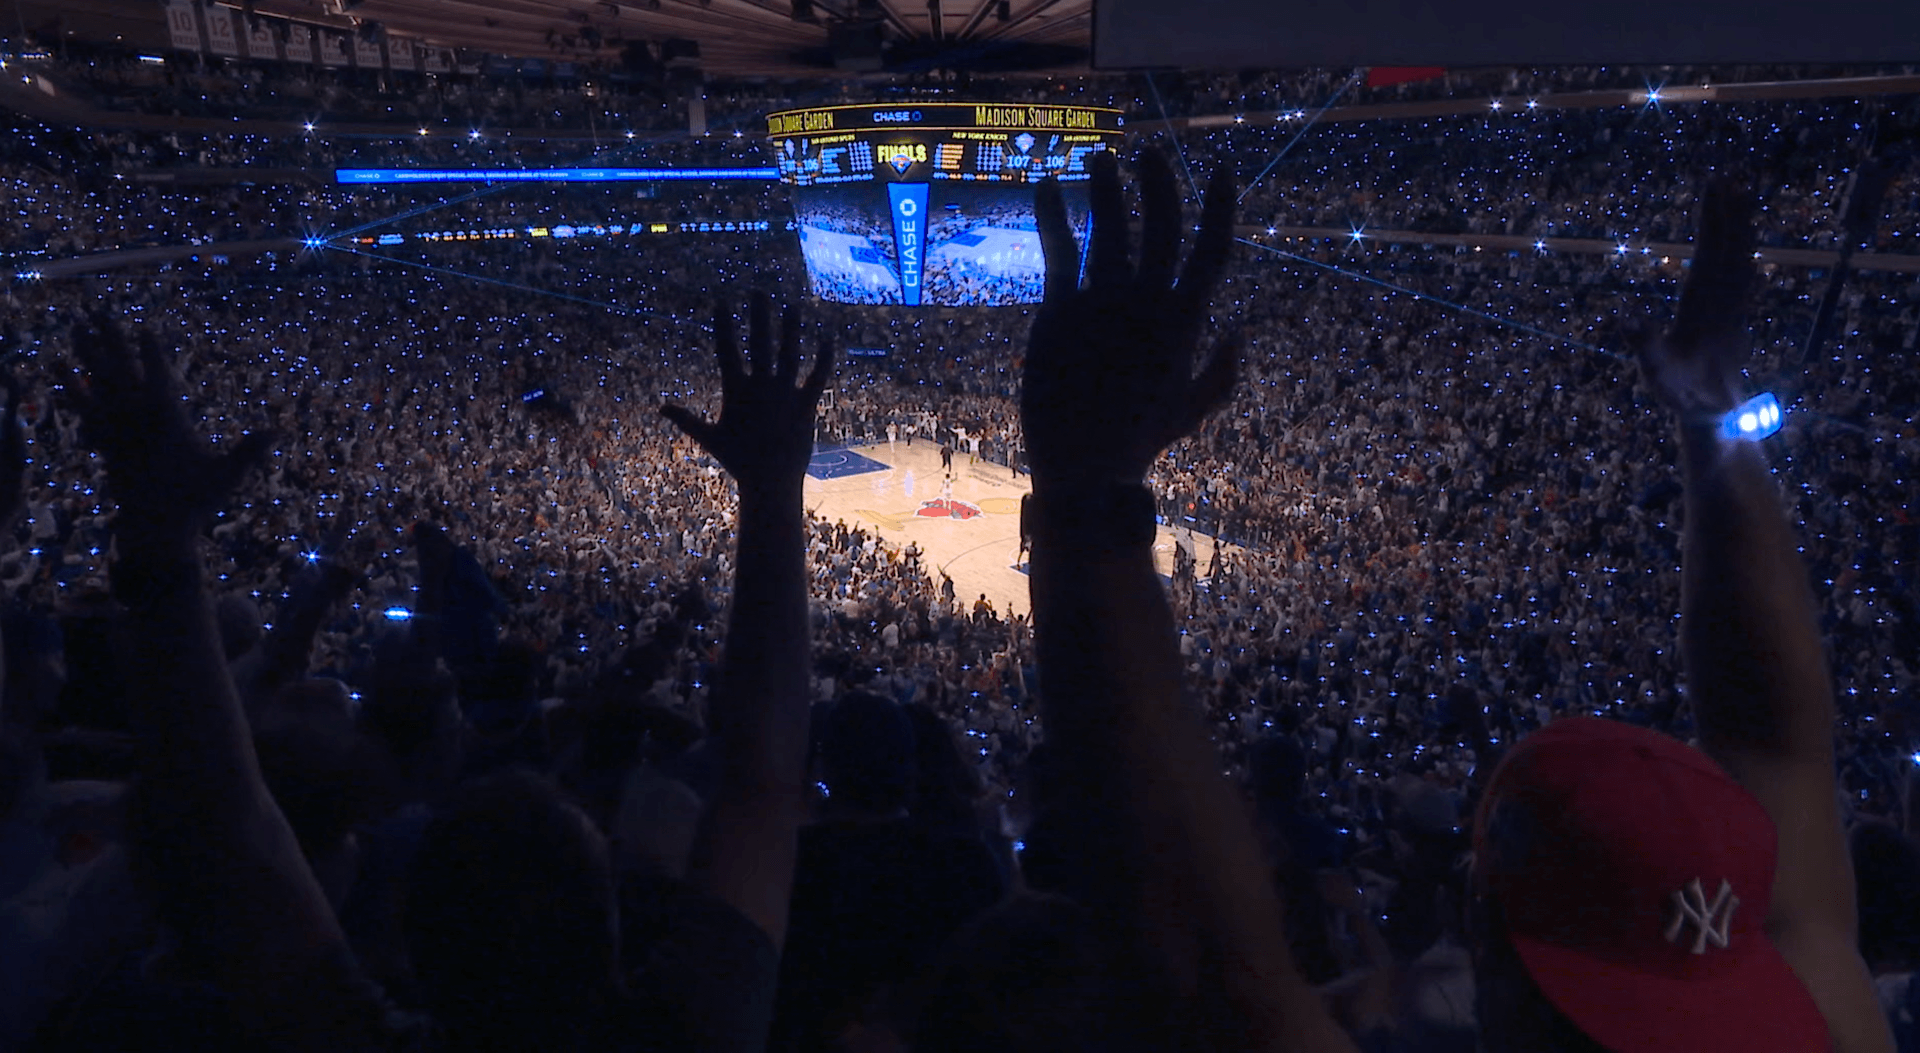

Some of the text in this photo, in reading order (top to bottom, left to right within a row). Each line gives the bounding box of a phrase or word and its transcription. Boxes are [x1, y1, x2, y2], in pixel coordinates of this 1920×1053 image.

[172, 10, 192, 32] 10
[210, 16, 231, 37] 12
[391, 39, 409, 55] 24
[804, 111, 834, 131] GARDEN
[873, 111, 910, 122] CHASE
[975, 106, 1025, 126] MADISON
[1028, 107, 1064, 128] SQUARE
[1066, 108, 1096, 129] GARDEN
[877, 144, 927, 163] FINALS
[1006, 155, 1031, 168] 107
[1045, 155, 1065, 168] 106
[901, 220, 918, 287] CHASE
[1663, 875, 1741, 956] NY
